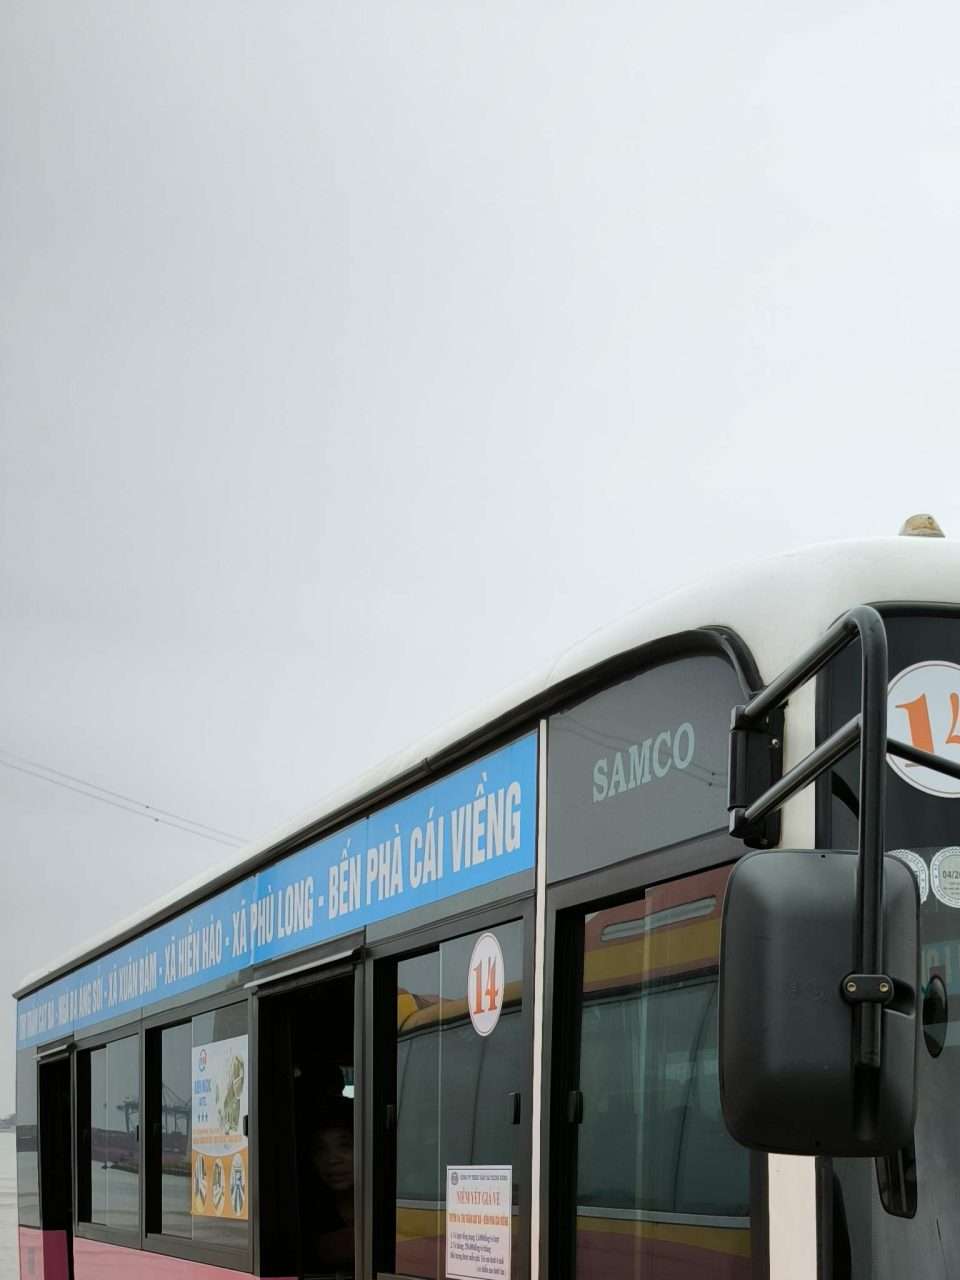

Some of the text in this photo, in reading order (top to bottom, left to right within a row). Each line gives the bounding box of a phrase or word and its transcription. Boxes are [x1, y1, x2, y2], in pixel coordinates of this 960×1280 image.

[593, 722, 695, 802] SAMCO
[278, 875, 314, 938] LONG
[328, 838, 362, 920] BẾN
[366, 823, 404, 905] PHÀ
[409, 806, 445, 889] CÁI
[451, 771, 521, 872] VIỀNG
[473, 955, 499, 1014] 14
